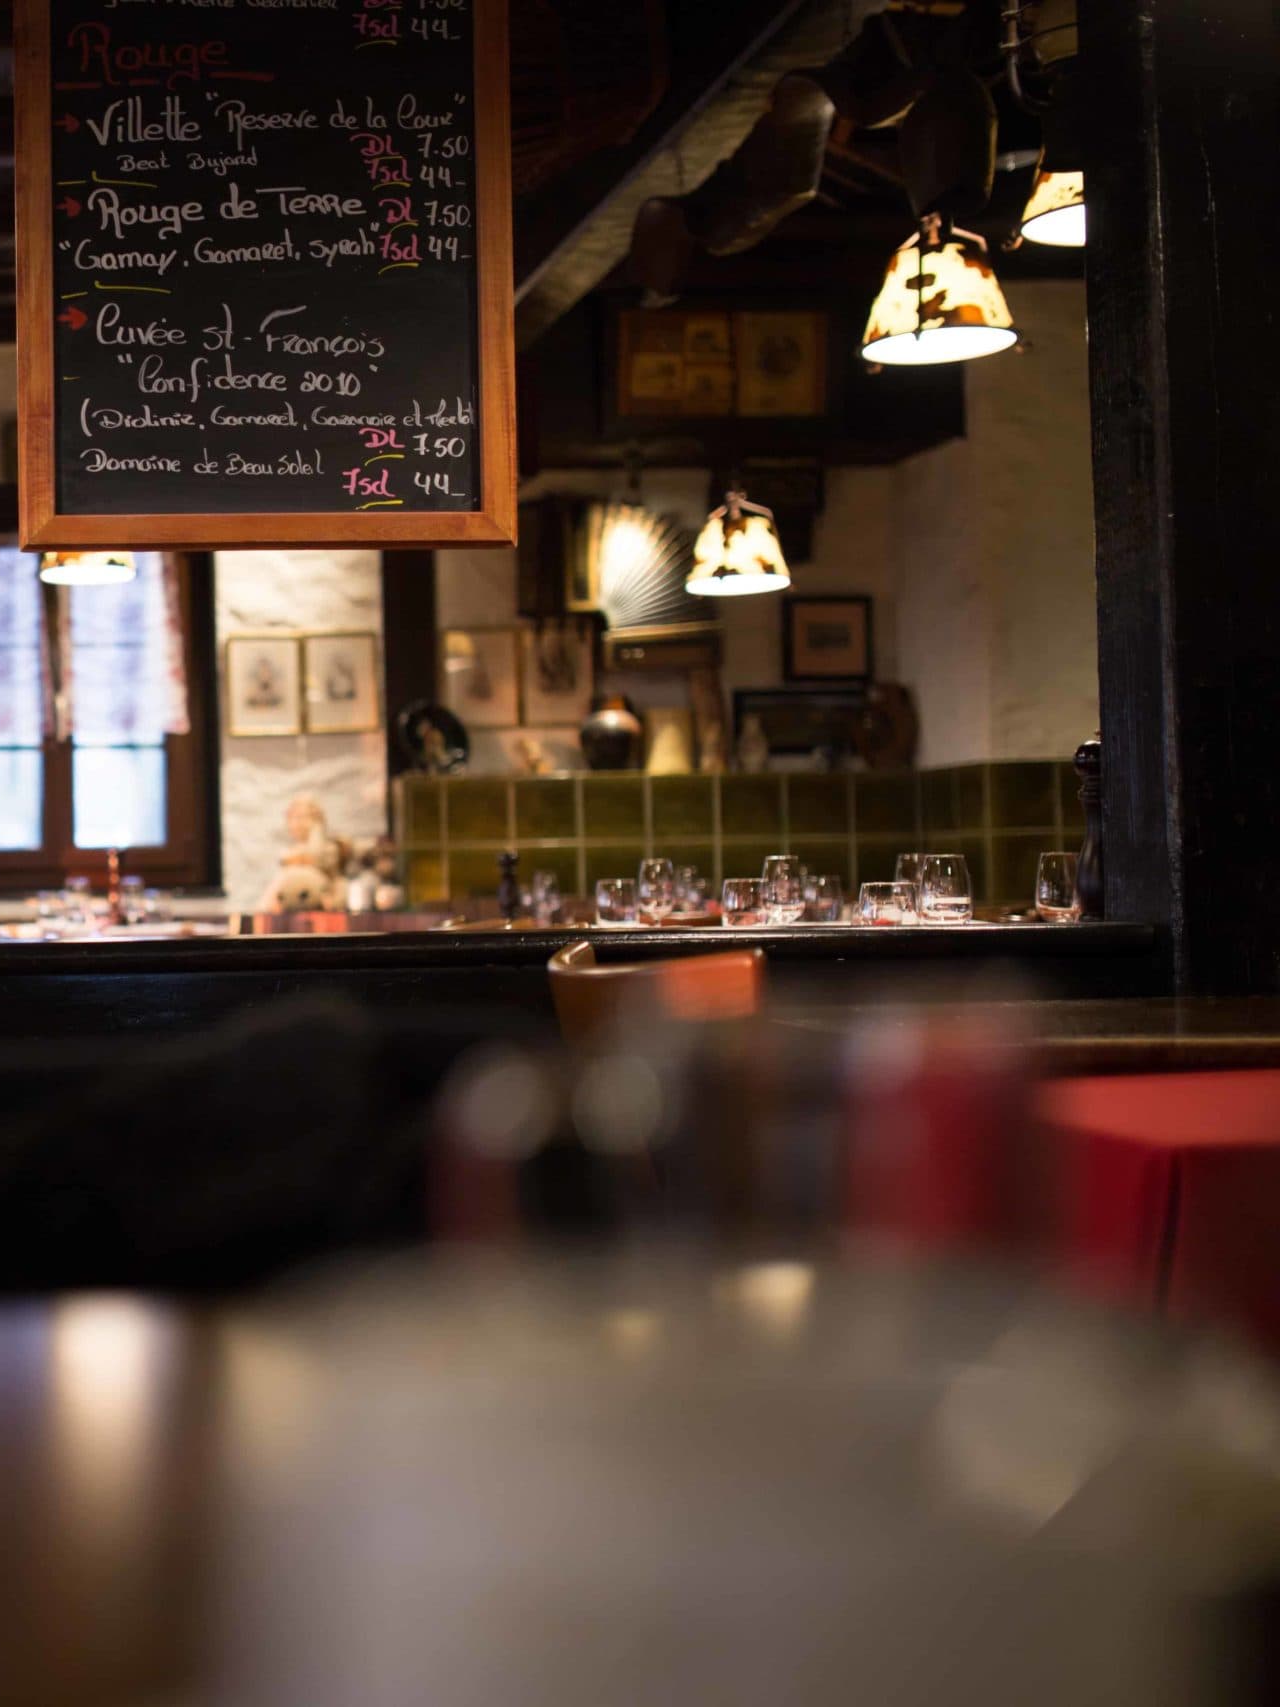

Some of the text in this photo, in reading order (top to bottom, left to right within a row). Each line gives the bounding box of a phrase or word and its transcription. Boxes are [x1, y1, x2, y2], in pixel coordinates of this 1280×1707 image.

[67, 21, 231, 90] Rouge
[86, 96, 202, 146] Villette
[329, 98, 358, 129] de
[366, 97, 388, 129] la
[120, 152, 170, 171] Beat
[88, 188, 204, 239] Rouge
[220, 183, 259, 219] de
[96, 302, 188, 346] Cuvée
[80, 447, 183, 473] Domaine
[193, 447, 220, 474] de
